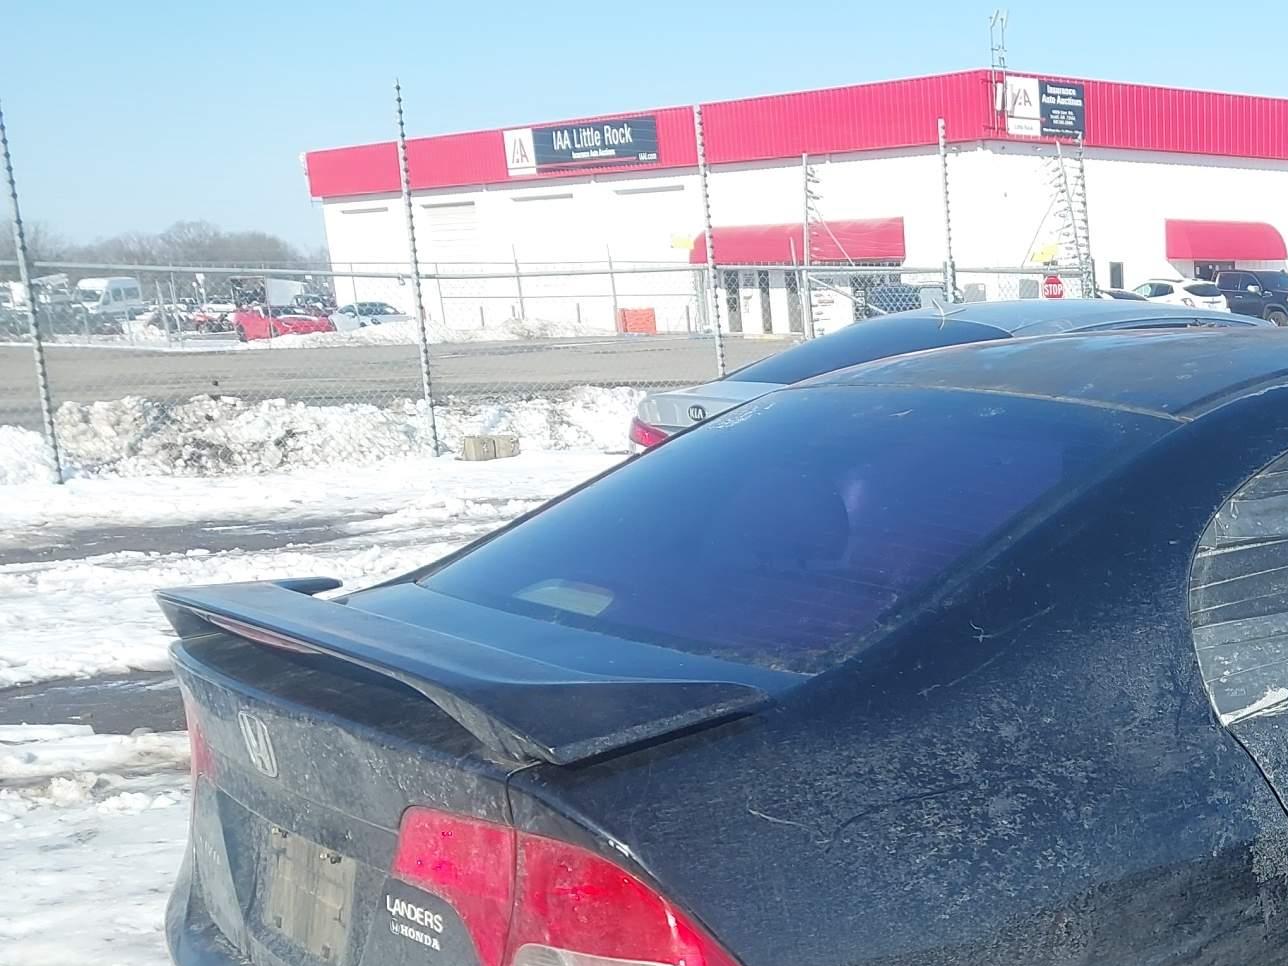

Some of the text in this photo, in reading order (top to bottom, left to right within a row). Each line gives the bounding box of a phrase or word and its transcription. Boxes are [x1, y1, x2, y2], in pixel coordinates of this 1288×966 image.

[552, 130, 572, 151] IAA
[573, 127, 600, 149] Little
[604, 123, 633, 145] Rock
[1044, 283, 1063, 296] STOP
[689, 407, 704, 420] KIA
[386, 894, 444, 934] LANDERS
[399, 924, 441, 951] HONDA
